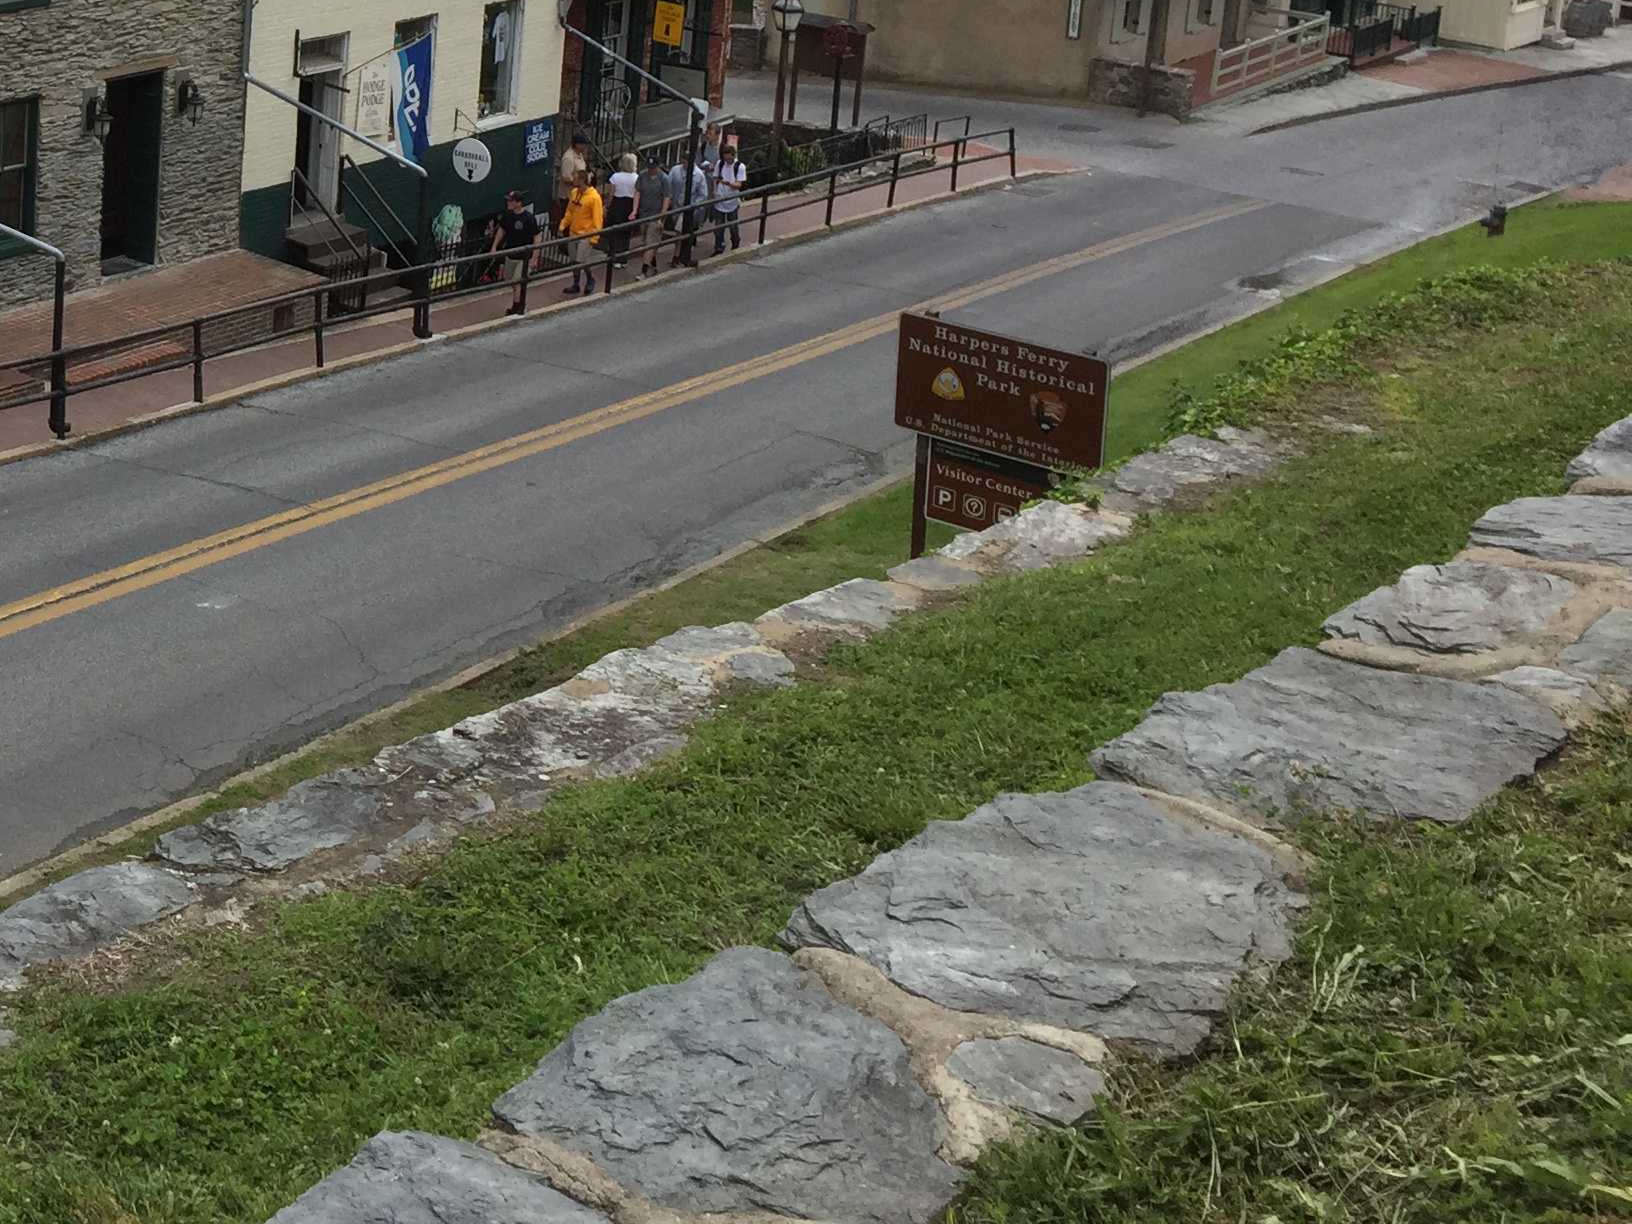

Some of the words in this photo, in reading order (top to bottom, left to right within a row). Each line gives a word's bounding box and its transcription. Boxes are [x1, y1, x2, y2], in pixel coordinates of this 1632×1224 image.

[526, 130, 550, 144] CREAM
[532, 122, 544, 134] ICE
[528, 142, 546, 154] COLD
[934, 326, 1009, 356] Harpers
[1017, 347, 1070, 373] Ferry
[908, 337, 987, 368] National
[996, 359, 1095, 396] Historical
[976, 373, 1021, 396] Park
[905, 415, 925, 429] U.S.
[930, 423, 997, 448] Department
[1001, 442, 1014, 453] of
[1018, 447, 1036, 461] the
[933, 413, 981, 433] National
[986, 427, 1013, 443] Park
[1016, 436, 1060, 454] Service
[936, 463, 983, 485] Visitor
[985, 478, 1033, 499] Center
[938, 489, 952, 505] P
